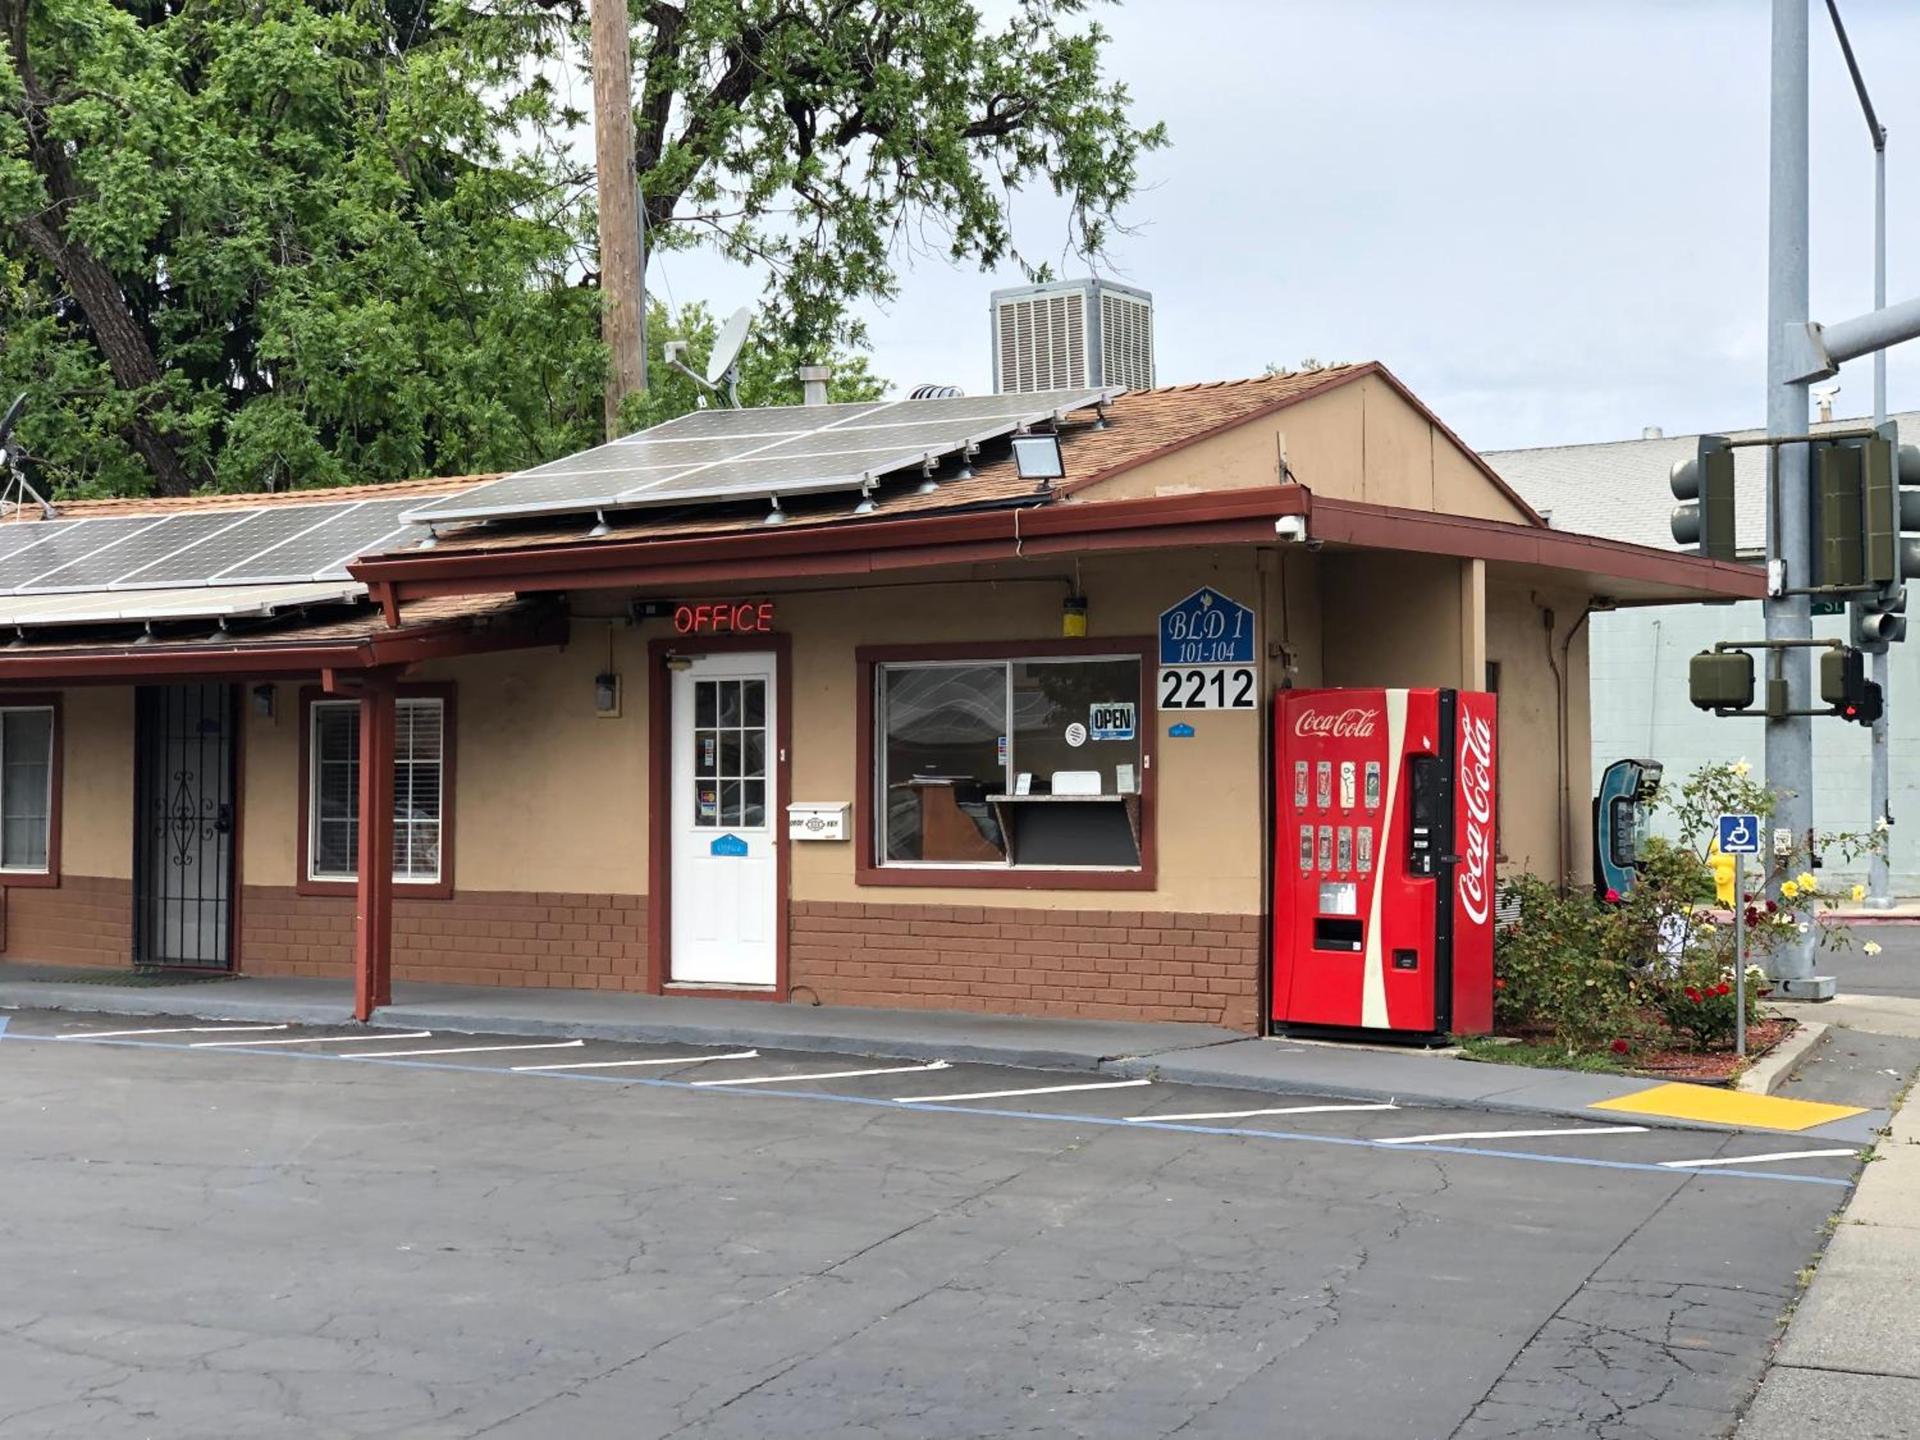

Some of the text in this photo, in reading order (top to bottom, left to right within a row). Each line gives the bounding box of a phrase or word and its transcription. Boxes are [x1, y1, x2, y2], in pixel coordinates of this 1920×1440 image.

[674, 603, 773, 633] OFFICE
[1168, 608, 1244, 640] BLD 1
[1178, 641, 1236, 662] 101-104
[1161, 668, 1254, 709] 2212
[1094, 708, 1131, 729] OPEN
